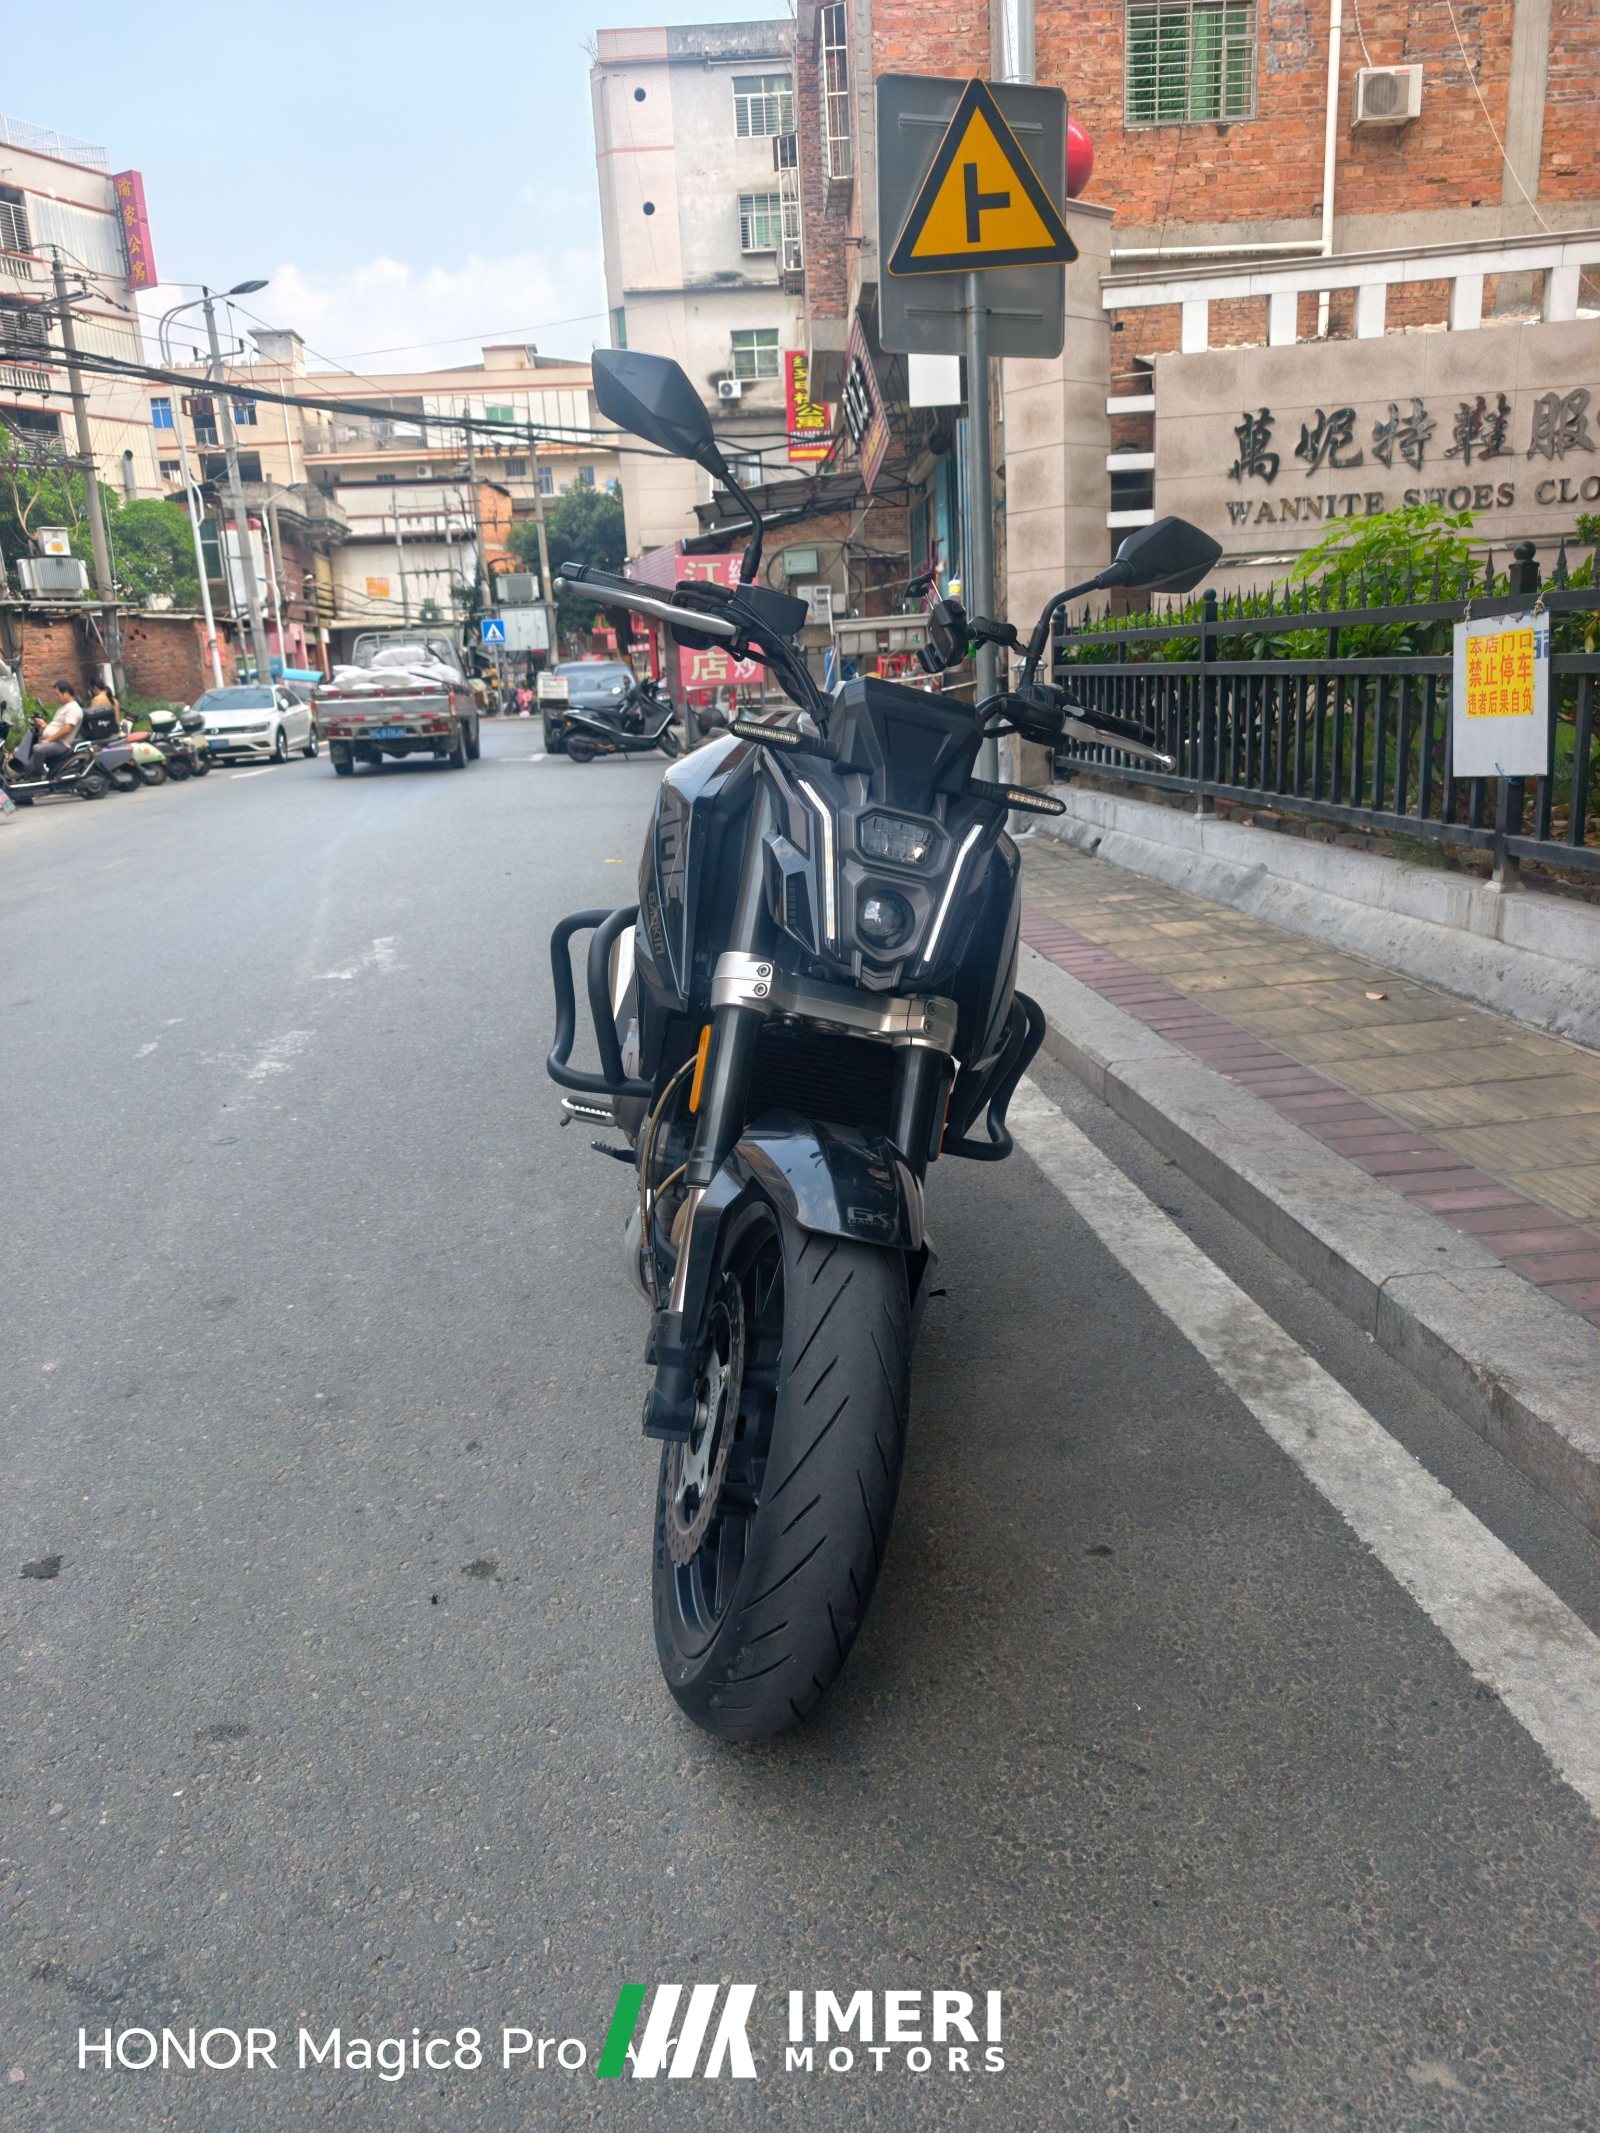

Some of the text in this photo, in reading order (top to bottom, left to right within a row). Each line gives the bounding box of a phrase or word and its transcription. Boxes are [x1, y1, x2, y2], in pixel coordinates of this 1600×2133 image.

[1227, 388, 1600, 485] 萬妮特鞋服
[1226, 475, 1600, 525] WANNITE SHOES CLO
[1470, 632, 1532, 656] 本店门口
[1469, 653, 1532, 688] 禁止停车
[1467, 687, 1532, 715] 违者后果自负
